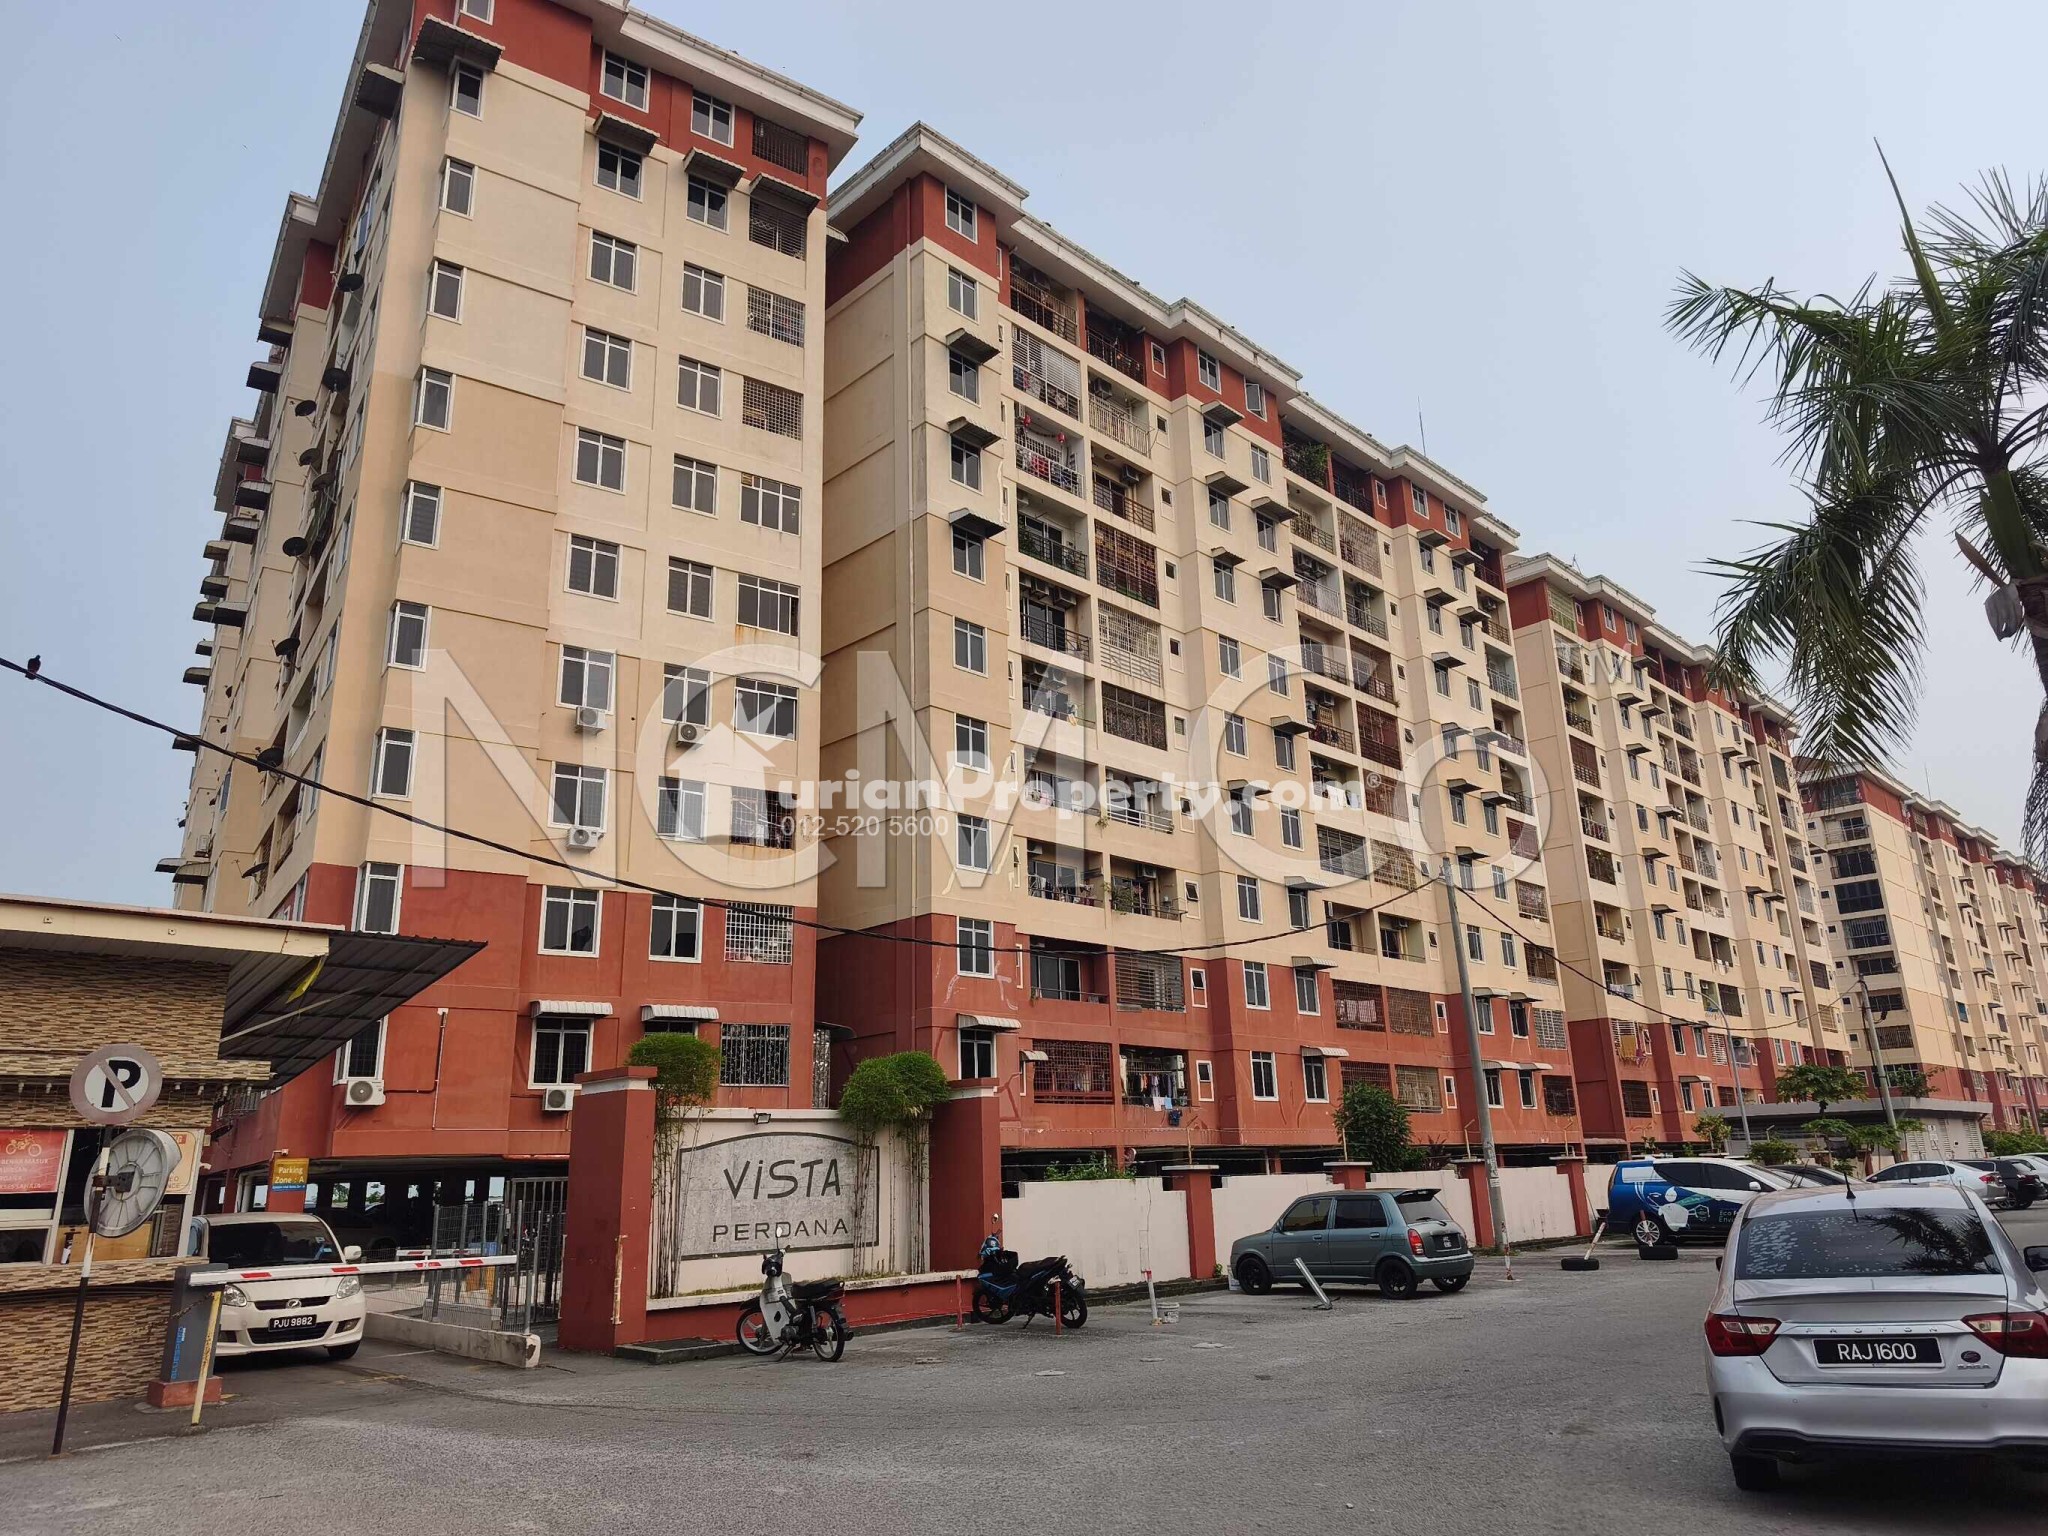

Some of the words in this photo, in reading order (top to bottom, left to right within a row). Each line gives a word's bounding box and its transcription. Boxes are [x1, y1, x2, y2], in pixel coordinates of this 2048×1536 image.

[101, 1060, 141, 1108] P
[278, 1166, 304, 1175] Parking
[274, 1176, 292, 1184] Zone
[712, 1218, 848, 1243] PERDANA
[273, 1318, 290, 1328] PJU
